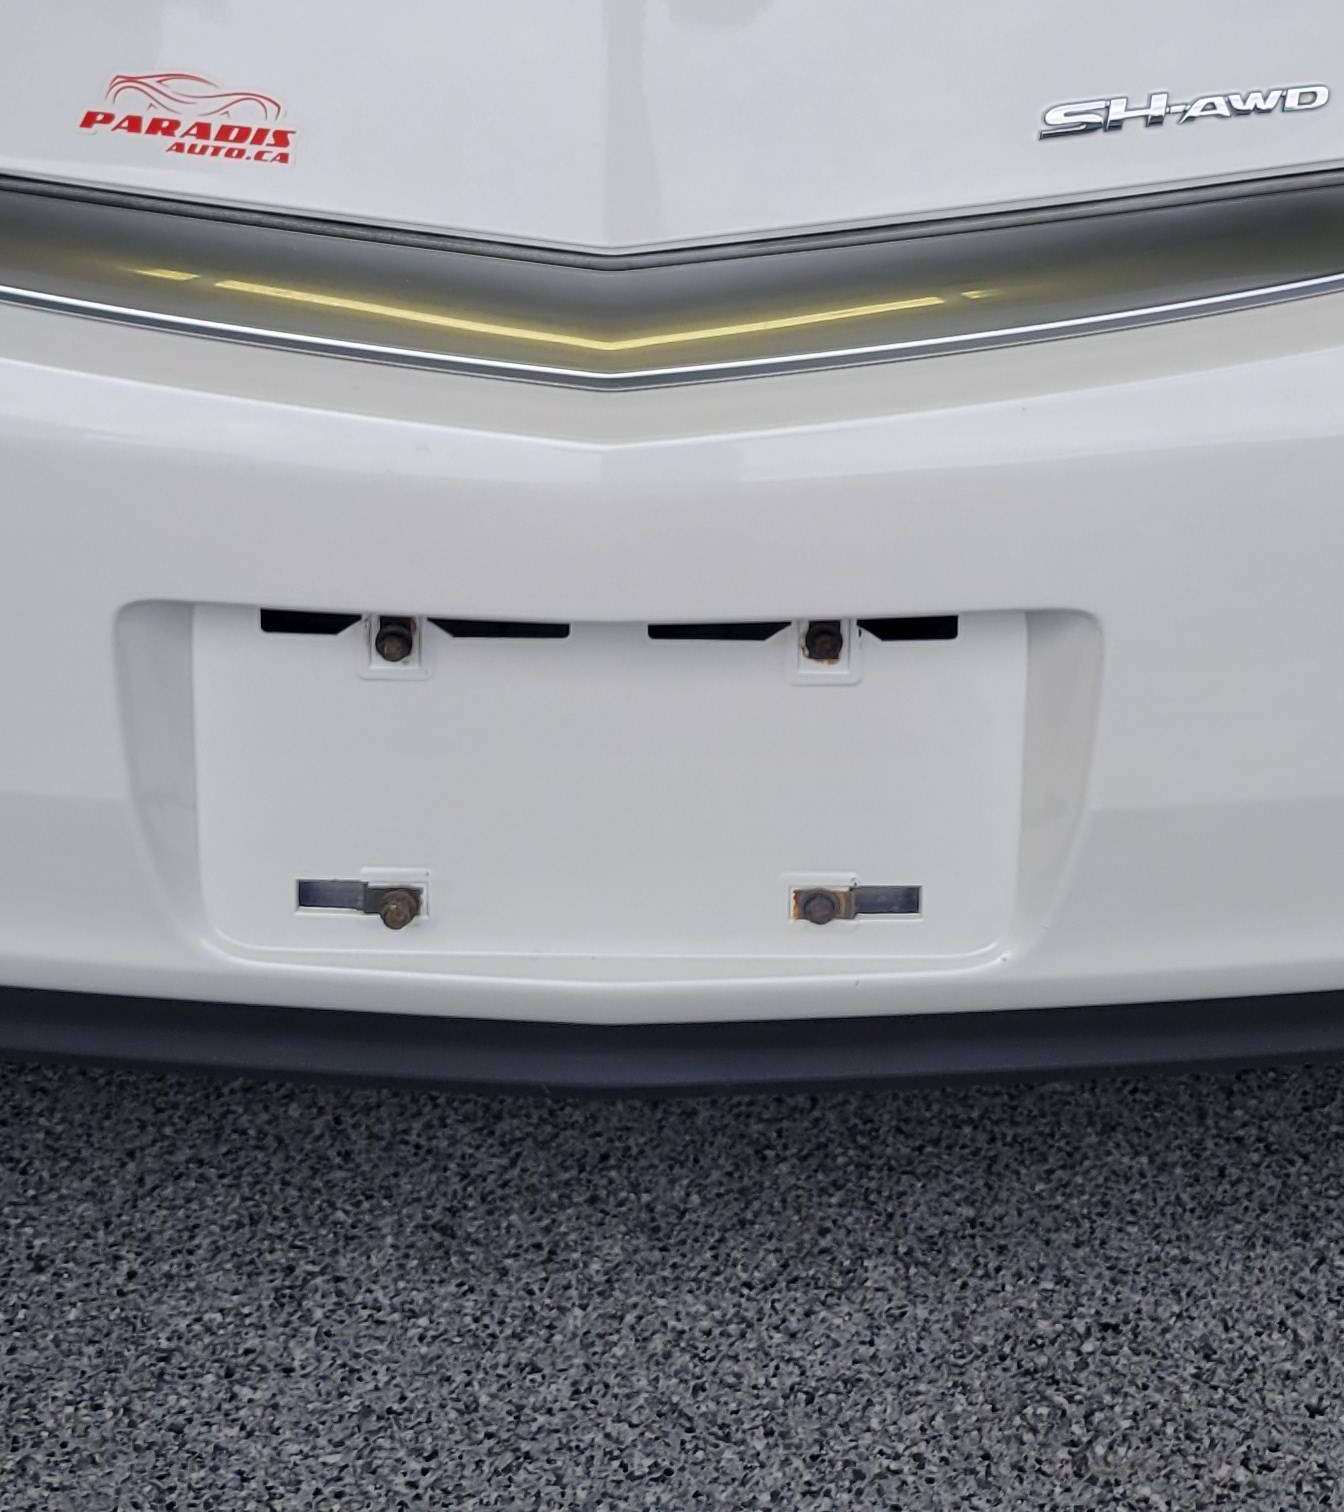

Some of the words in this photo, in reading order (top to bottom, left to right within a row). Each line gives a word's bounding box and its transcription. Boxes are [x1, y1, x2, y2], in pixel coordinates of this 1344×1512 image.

[79, 110, 297, 148] PARADIS
[1039, 83, 1331, 141] SH-AWD
[165, 141, 290, 165] AUTO.CA
